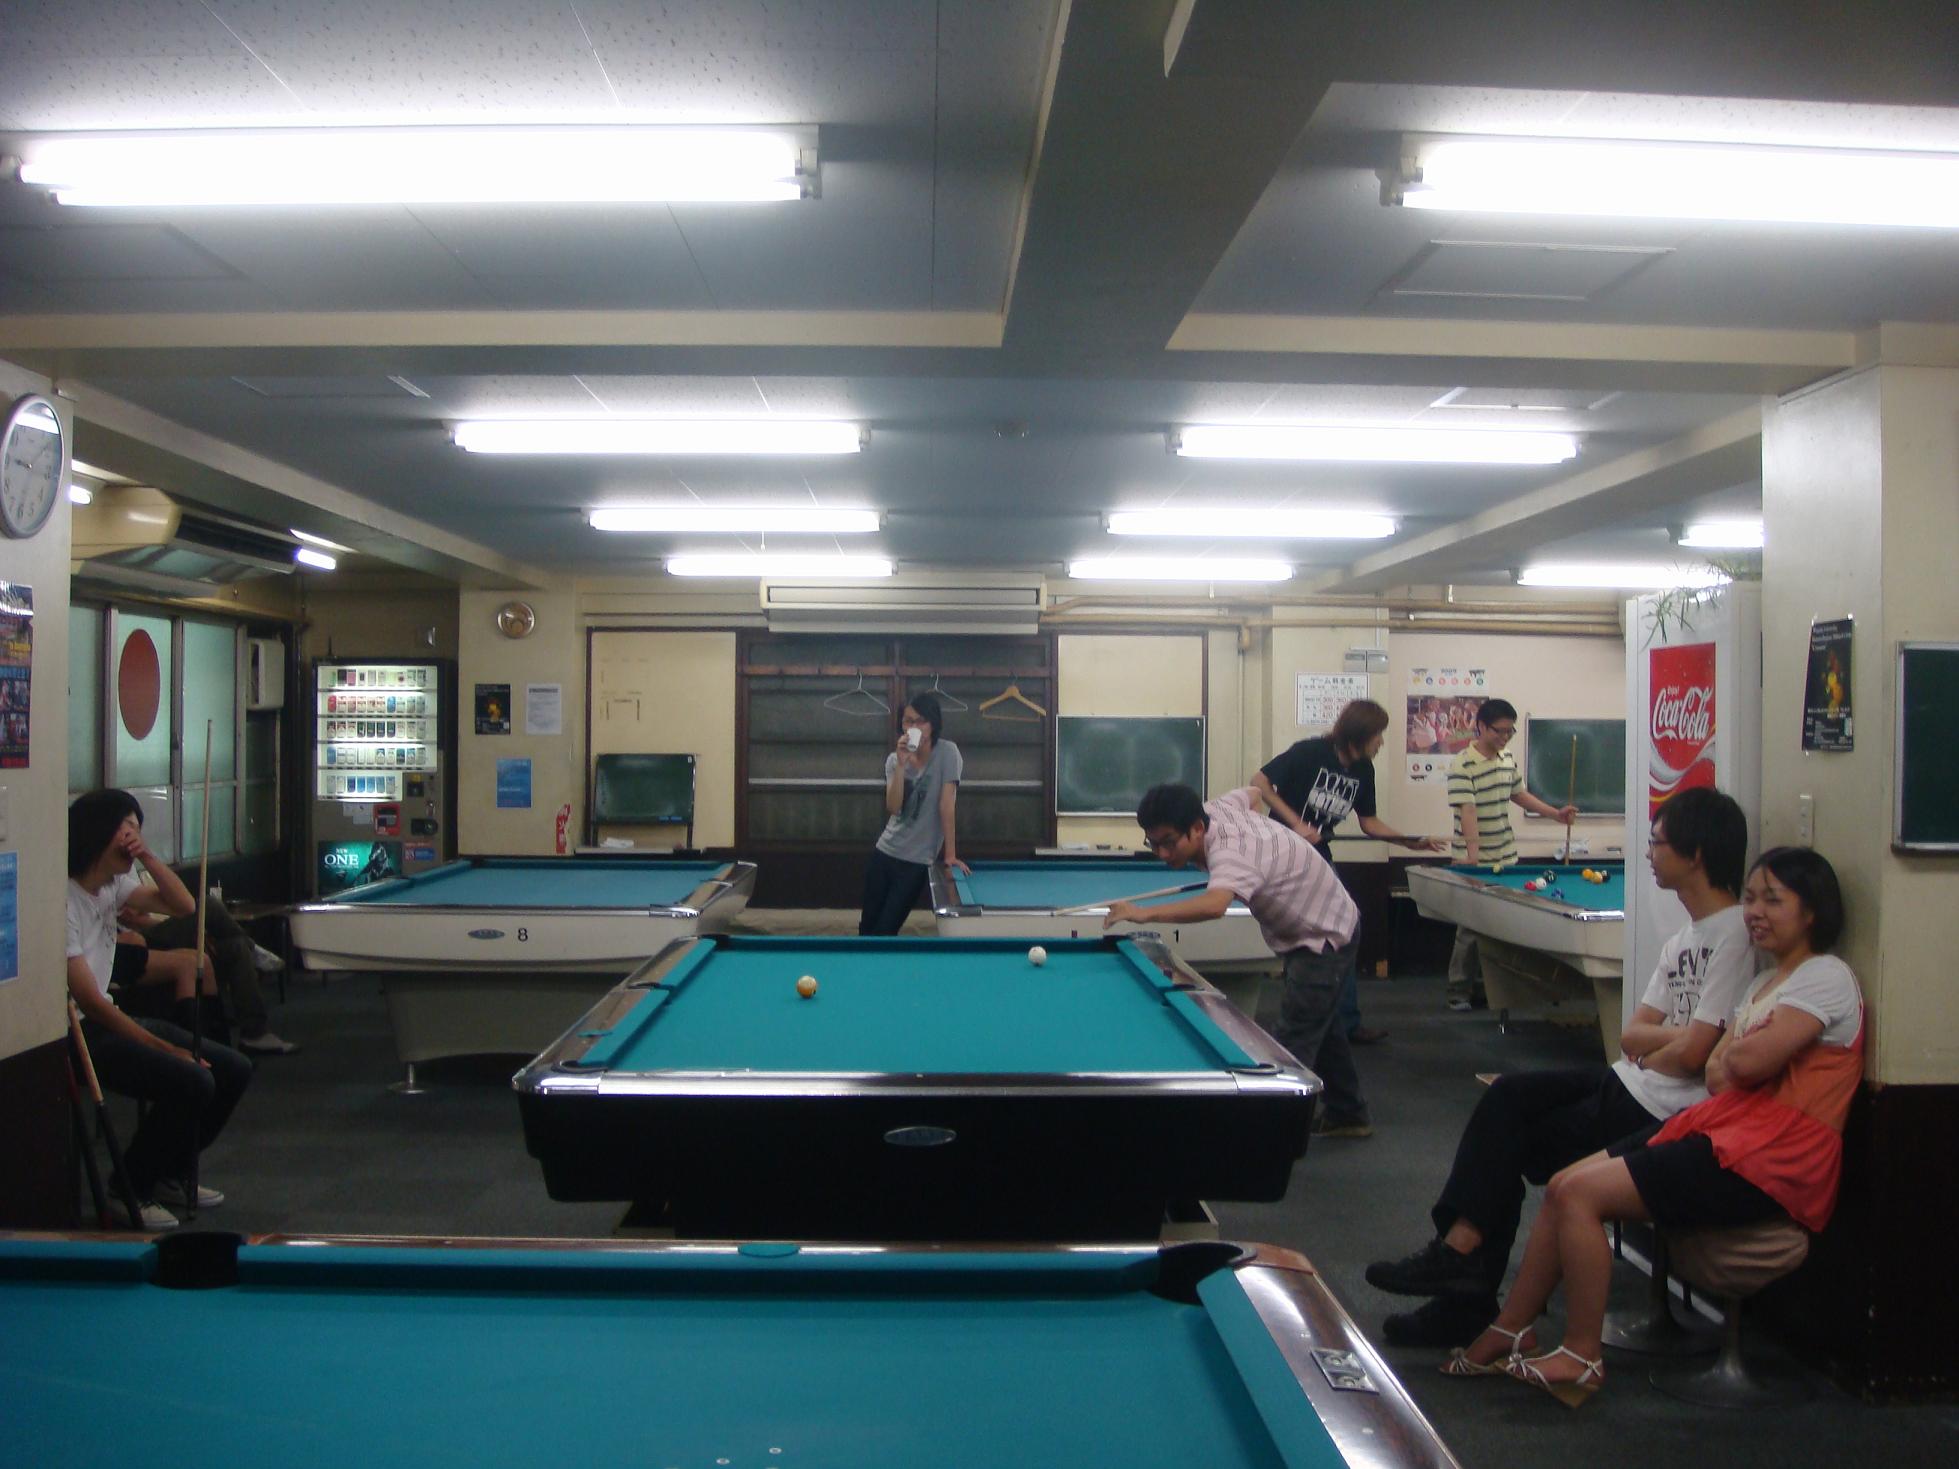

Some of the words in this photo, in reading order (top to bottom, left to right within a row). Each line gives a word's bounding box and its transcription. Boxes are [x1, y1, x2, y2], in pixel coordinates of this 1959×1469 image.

[324, 854, 360, 865] ONE
[517, 927, 528, 942] 8
[1173, 929, 1179, 944] 1
